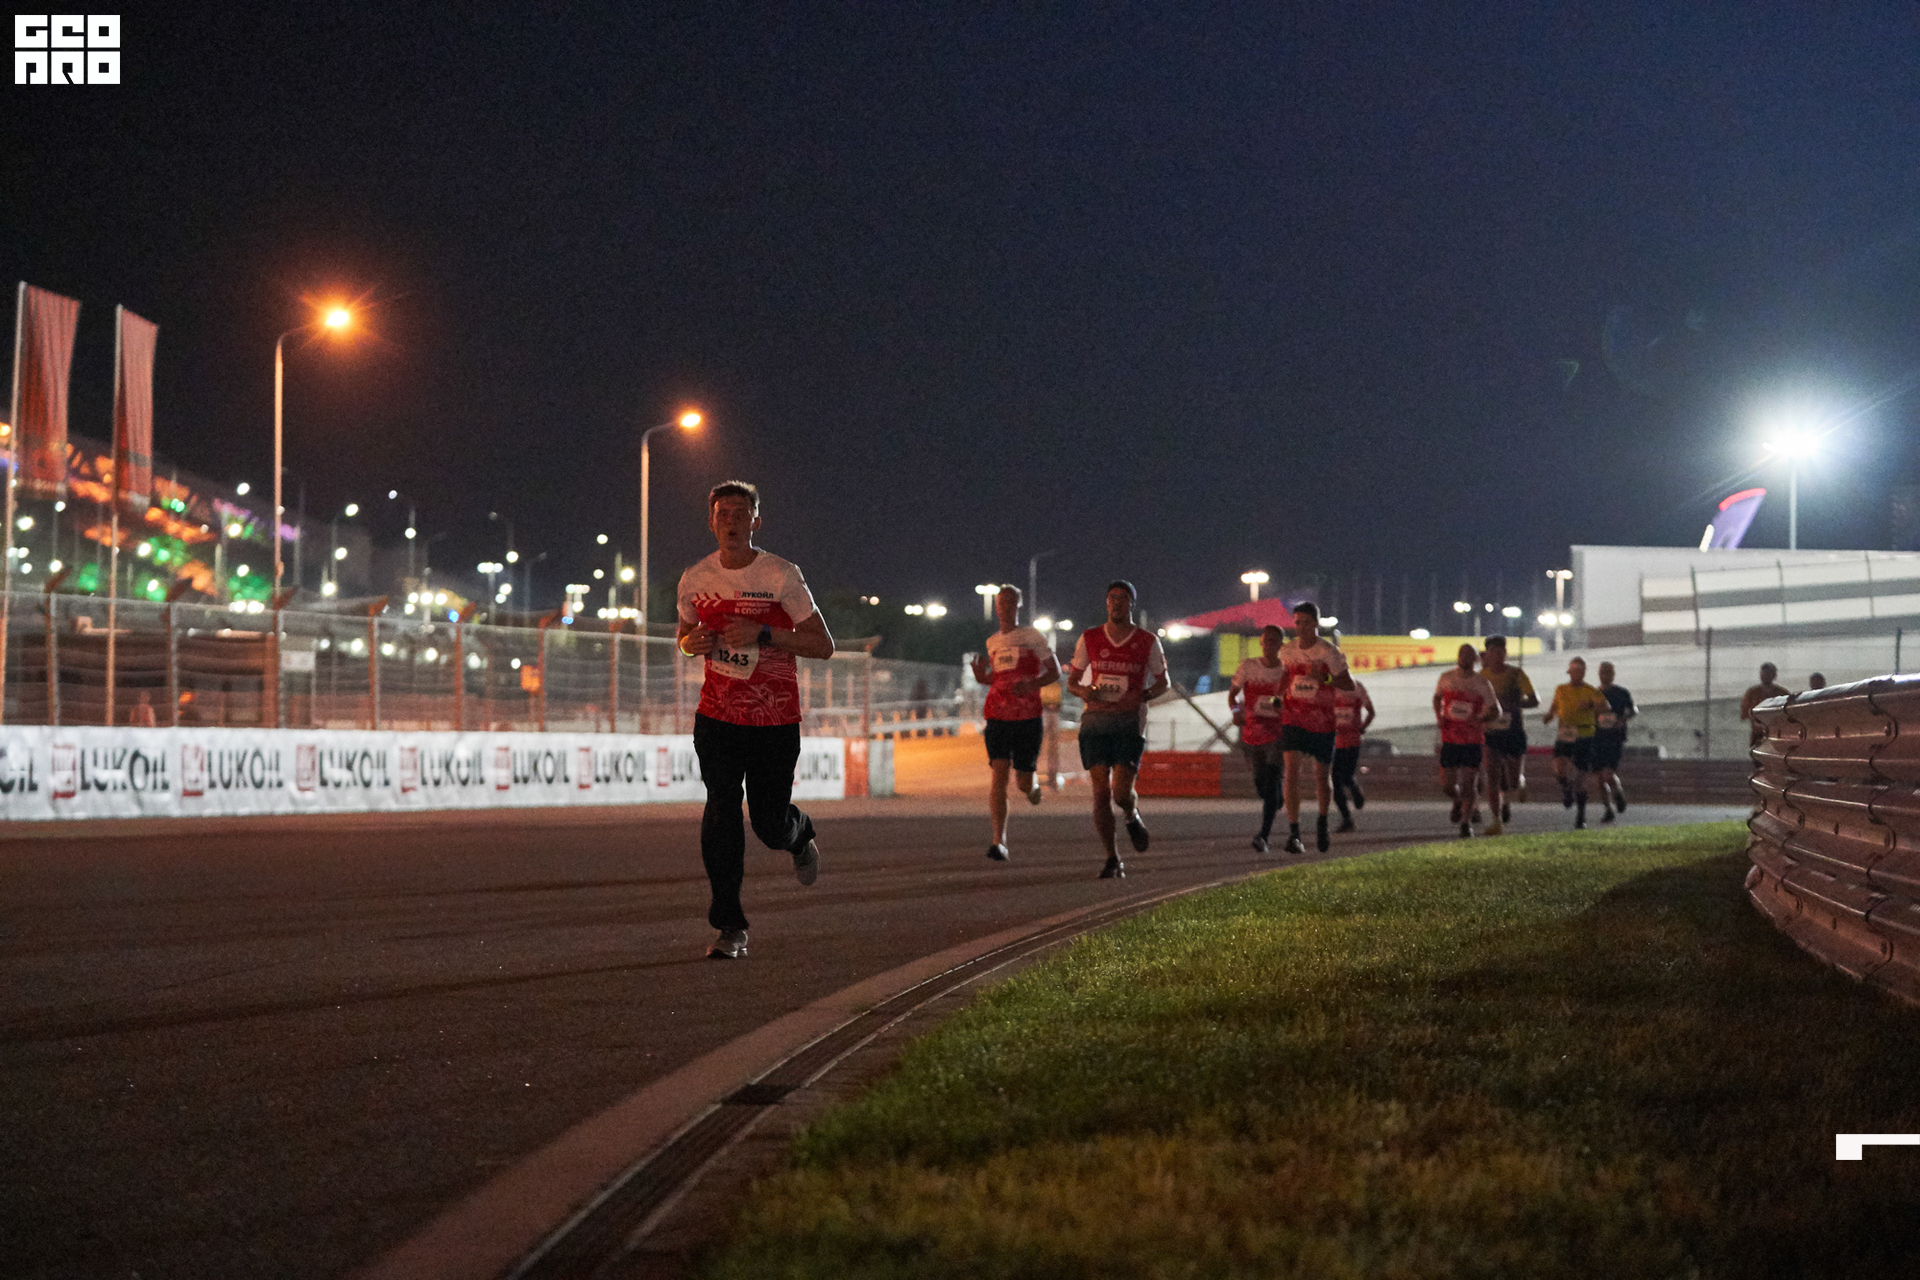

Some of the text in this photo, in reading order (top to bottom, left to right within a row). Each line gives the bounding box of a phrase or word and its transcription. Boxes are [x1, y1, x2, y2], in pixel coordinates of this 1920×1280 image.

[741, 590, 774, 599] ЛУКОЙЛ
[719, 648, 749, 667] 1243
[80, 748, 169, 792] LUKOIL
[208, 749, 283, 790] LUKOIL
[319, 749, 390, 788] LUKOIL
[420, 750, 485, 787] LUKOIL
[513, 750, 570, 785] LUKOIL
[594, 750, 648, 784] LUKOIL
